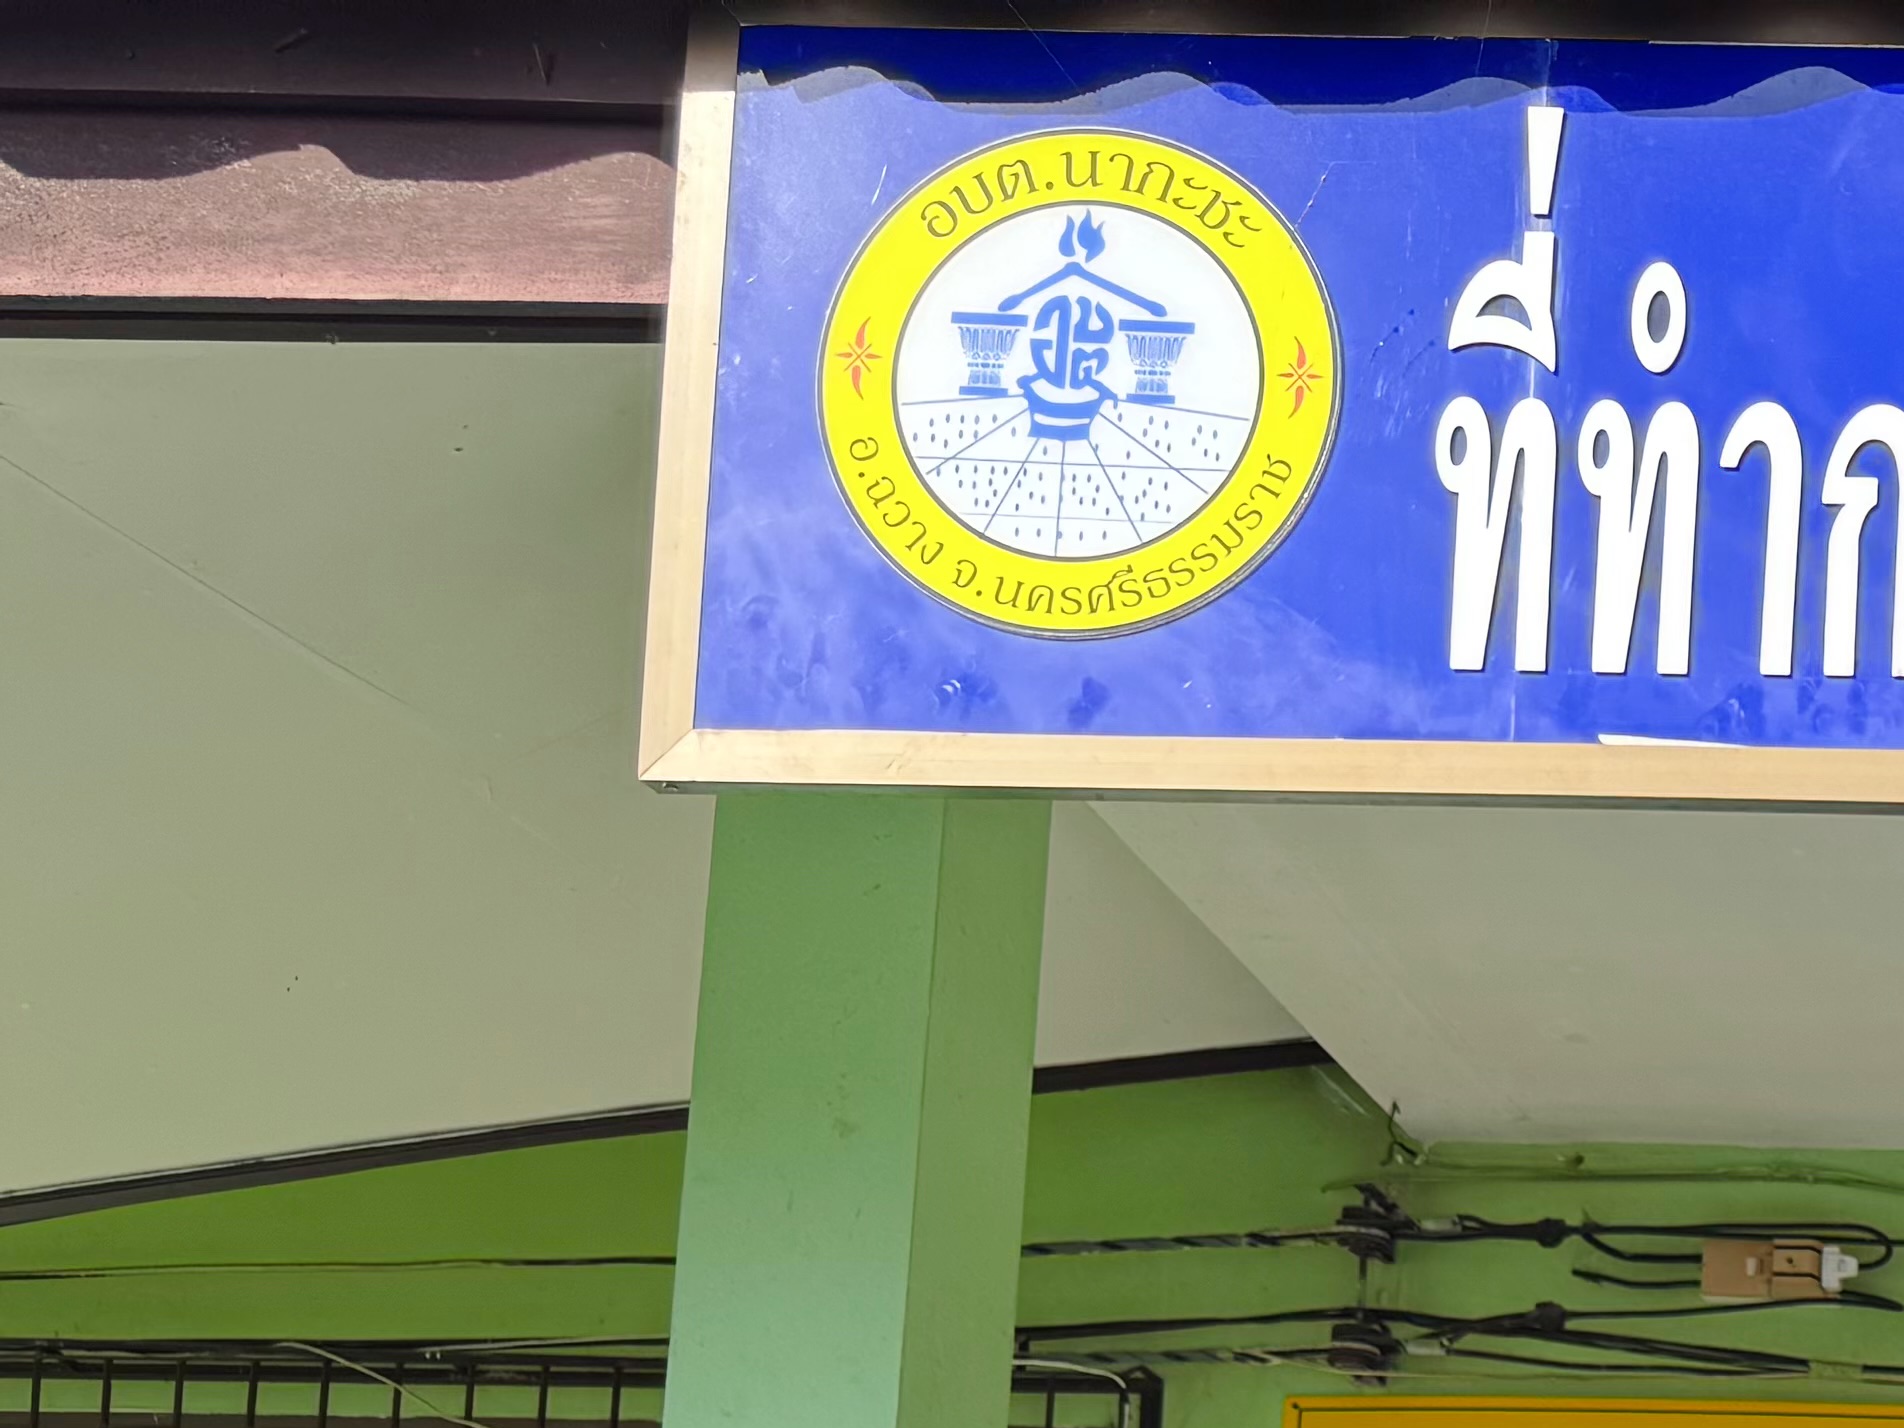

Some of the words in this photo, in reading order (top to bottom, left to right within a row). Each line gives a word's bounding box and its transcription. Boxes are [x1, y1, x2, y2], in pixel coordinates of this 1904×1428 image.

[920, 149, 1263, 249] อบต.นากะชะ
[848, 436, 944, 566] อ.ฉวาง
